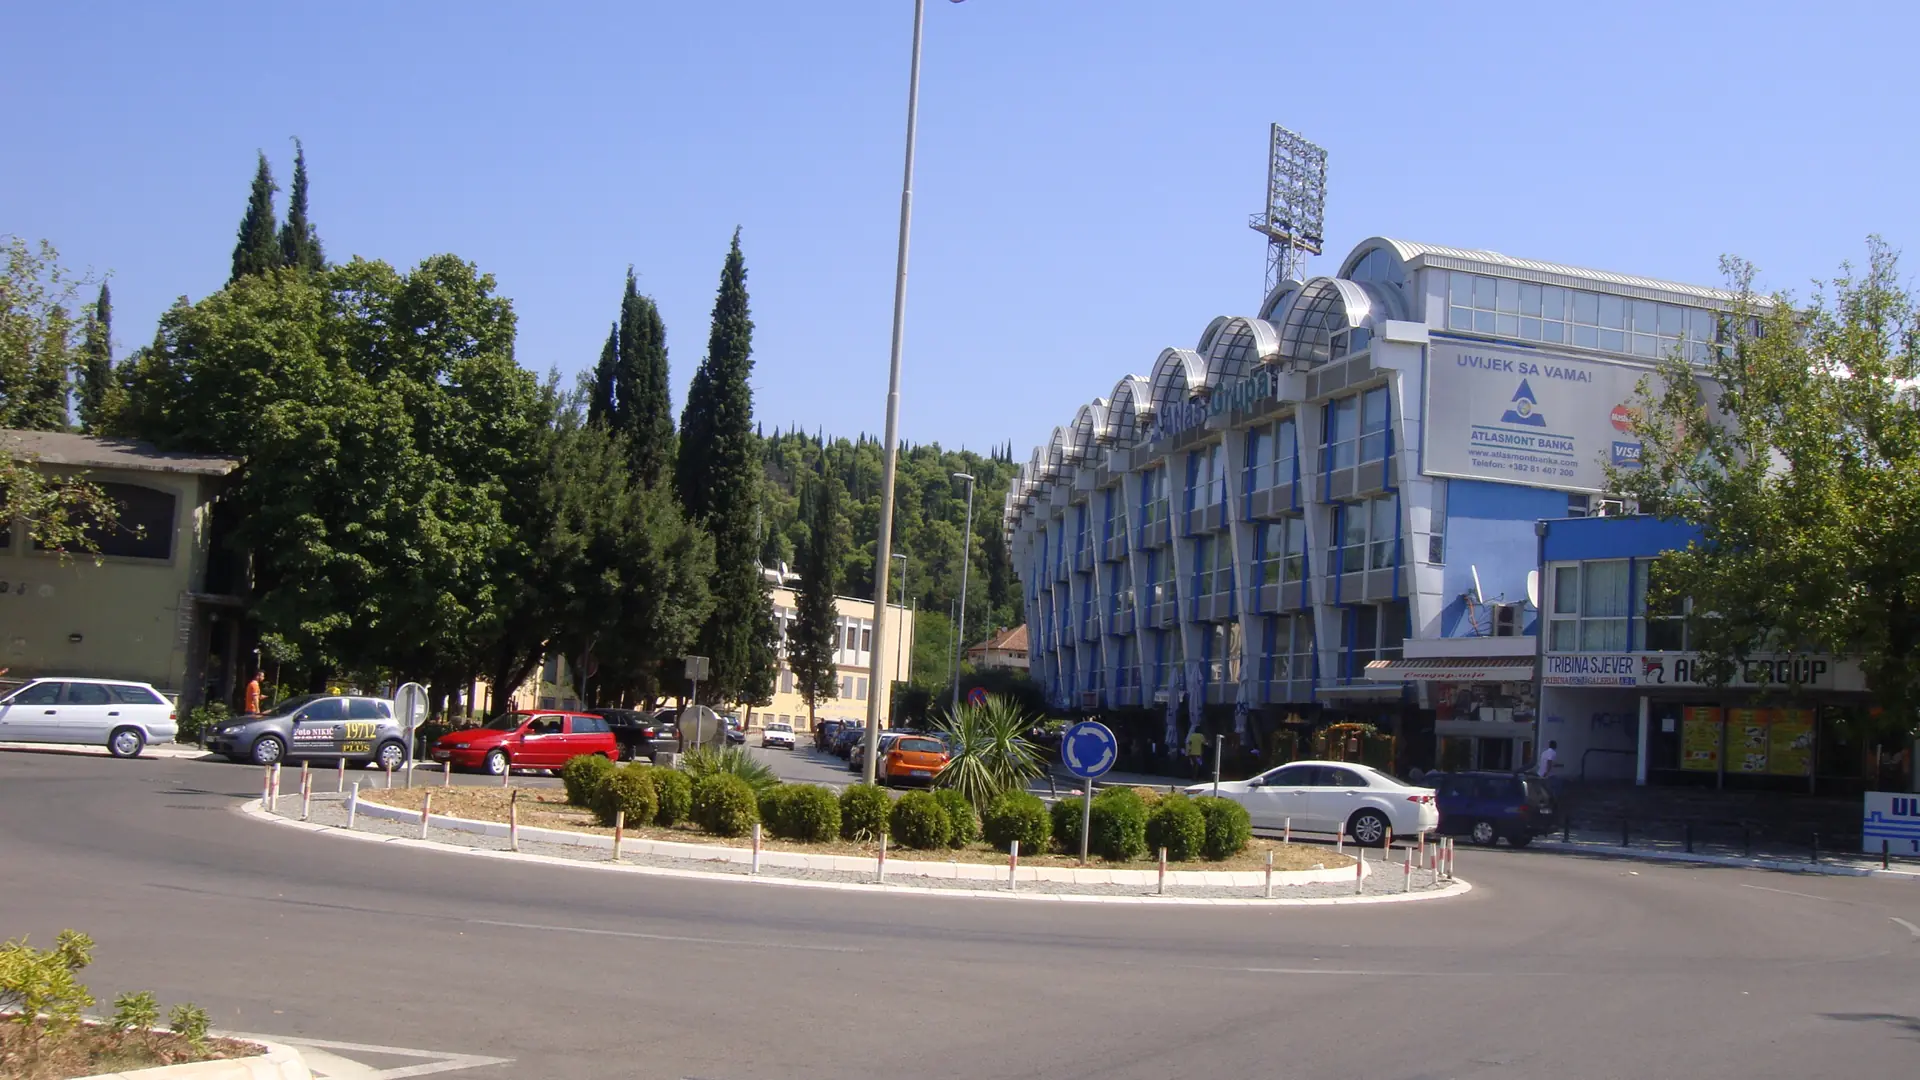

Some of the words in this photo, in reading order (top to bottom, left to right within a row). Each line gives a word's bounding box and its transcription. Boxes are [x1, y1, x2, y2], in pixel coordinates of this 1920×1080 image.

[1457, 354, 1513, 373] UVIJEK
[1518, 362, 1540, 376] SA
[1544, 366, 1592, 383] VAMA!
[1470, 431, 1535, 446] ATLASMONT
[1538, 439, 1574, 451] BANKA
[1468, 449, 1578, 467] www.atlasmontbanka.com
[1615, 446, 1640, 458] VISA
[1472, 458, 1506, 469] Telefon:
[1508, 463, 1529, 472] +382
[1530, 465, 1540, 473] 81
[1559, 468, 1574, 477] 200
[1548, 656, 1588, 673] TRIBINA
[1591, 656, 1634, 674] SJEVER
[294, 728, 311, 736] Foto
[345, 722, 377, 739] 19712
